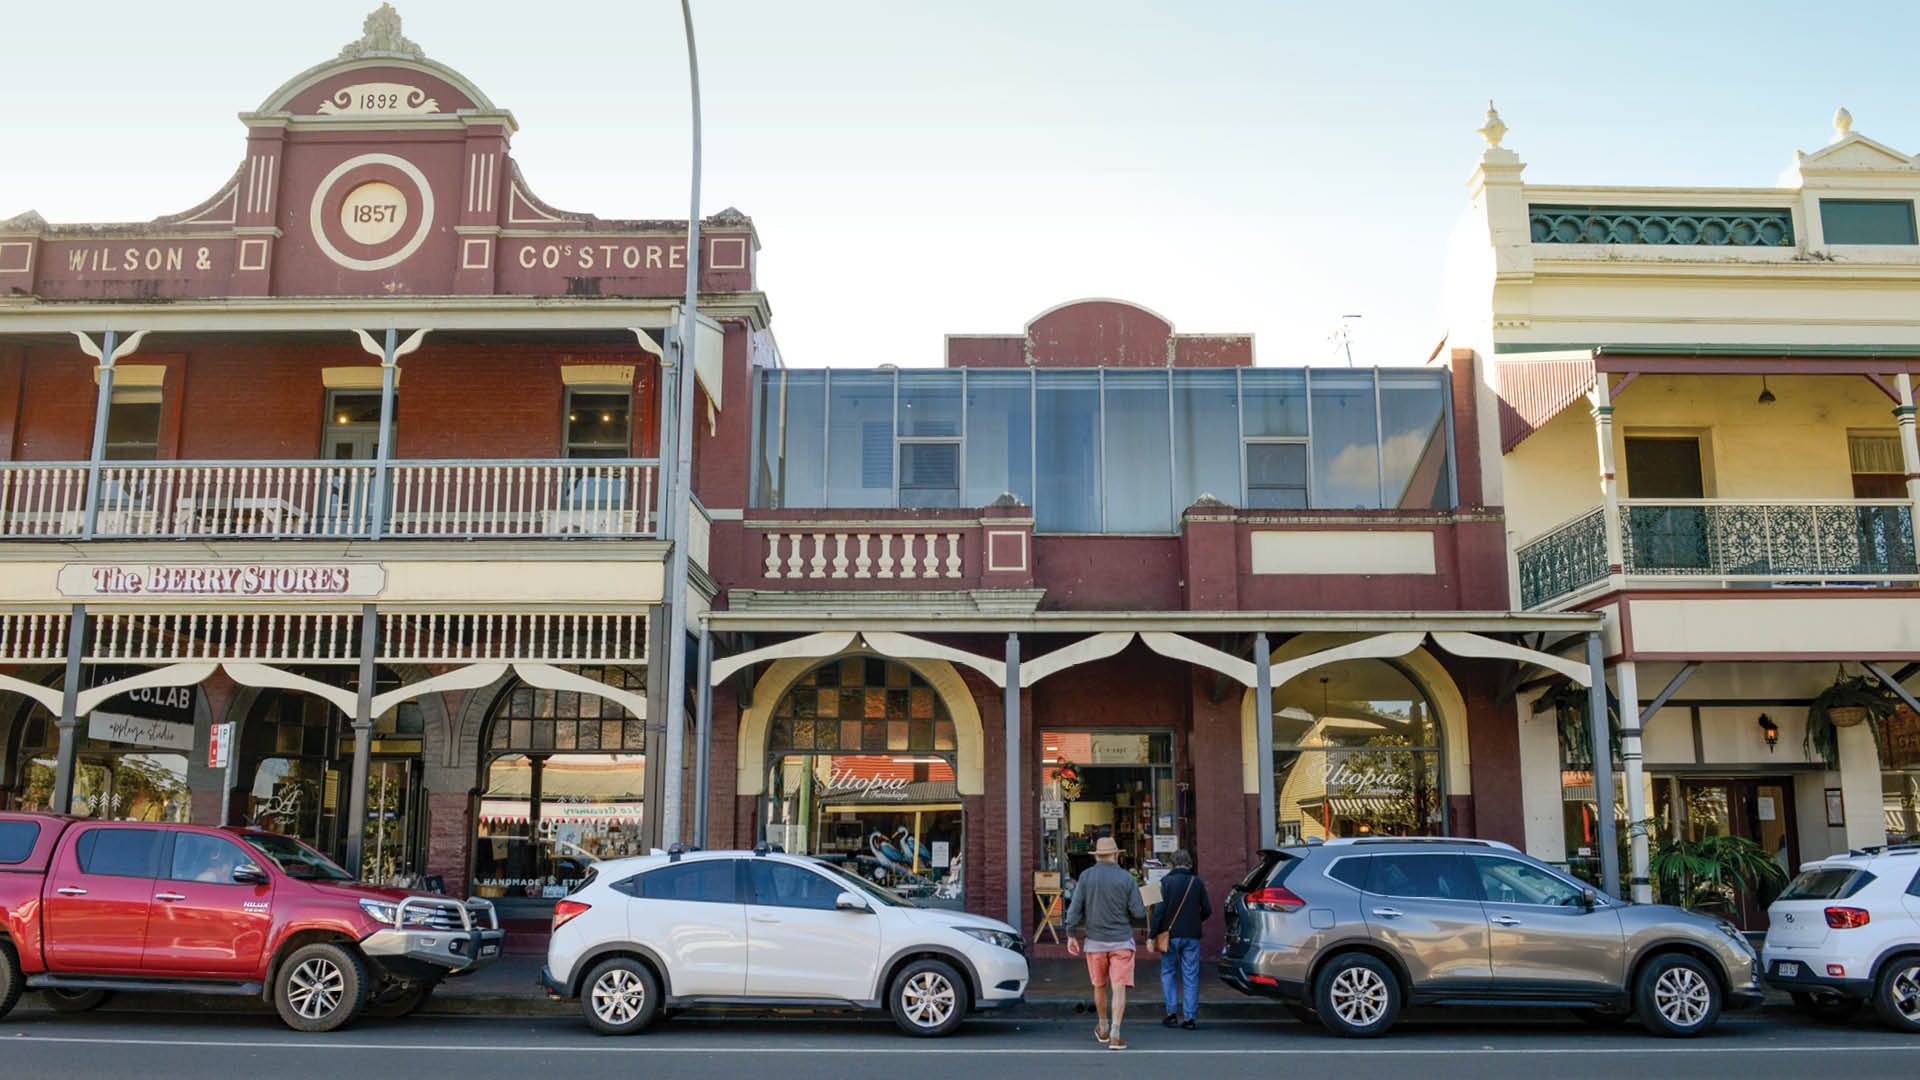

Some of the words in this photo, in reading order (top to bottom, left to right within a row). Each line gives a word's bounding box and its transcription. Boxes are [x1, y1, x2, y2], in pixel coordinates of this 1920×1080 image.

[360, 93, 398, 110] 1892
[353, 204, 397, 223] 1857
[68, 247, 184, 272] WILSON
[195, 246, 212, 270] &
[578, 245, 686, 269] STORE
[93, 567, 142, 593] The
[147, 566, 242, 593] BERRY
[242, 566, 350, 594] STORES
[827, 768, 908, 797] Utopia
[1321, 763, 1403, 794] Utopia
[483, 878, 541, 887] HANDMADE
